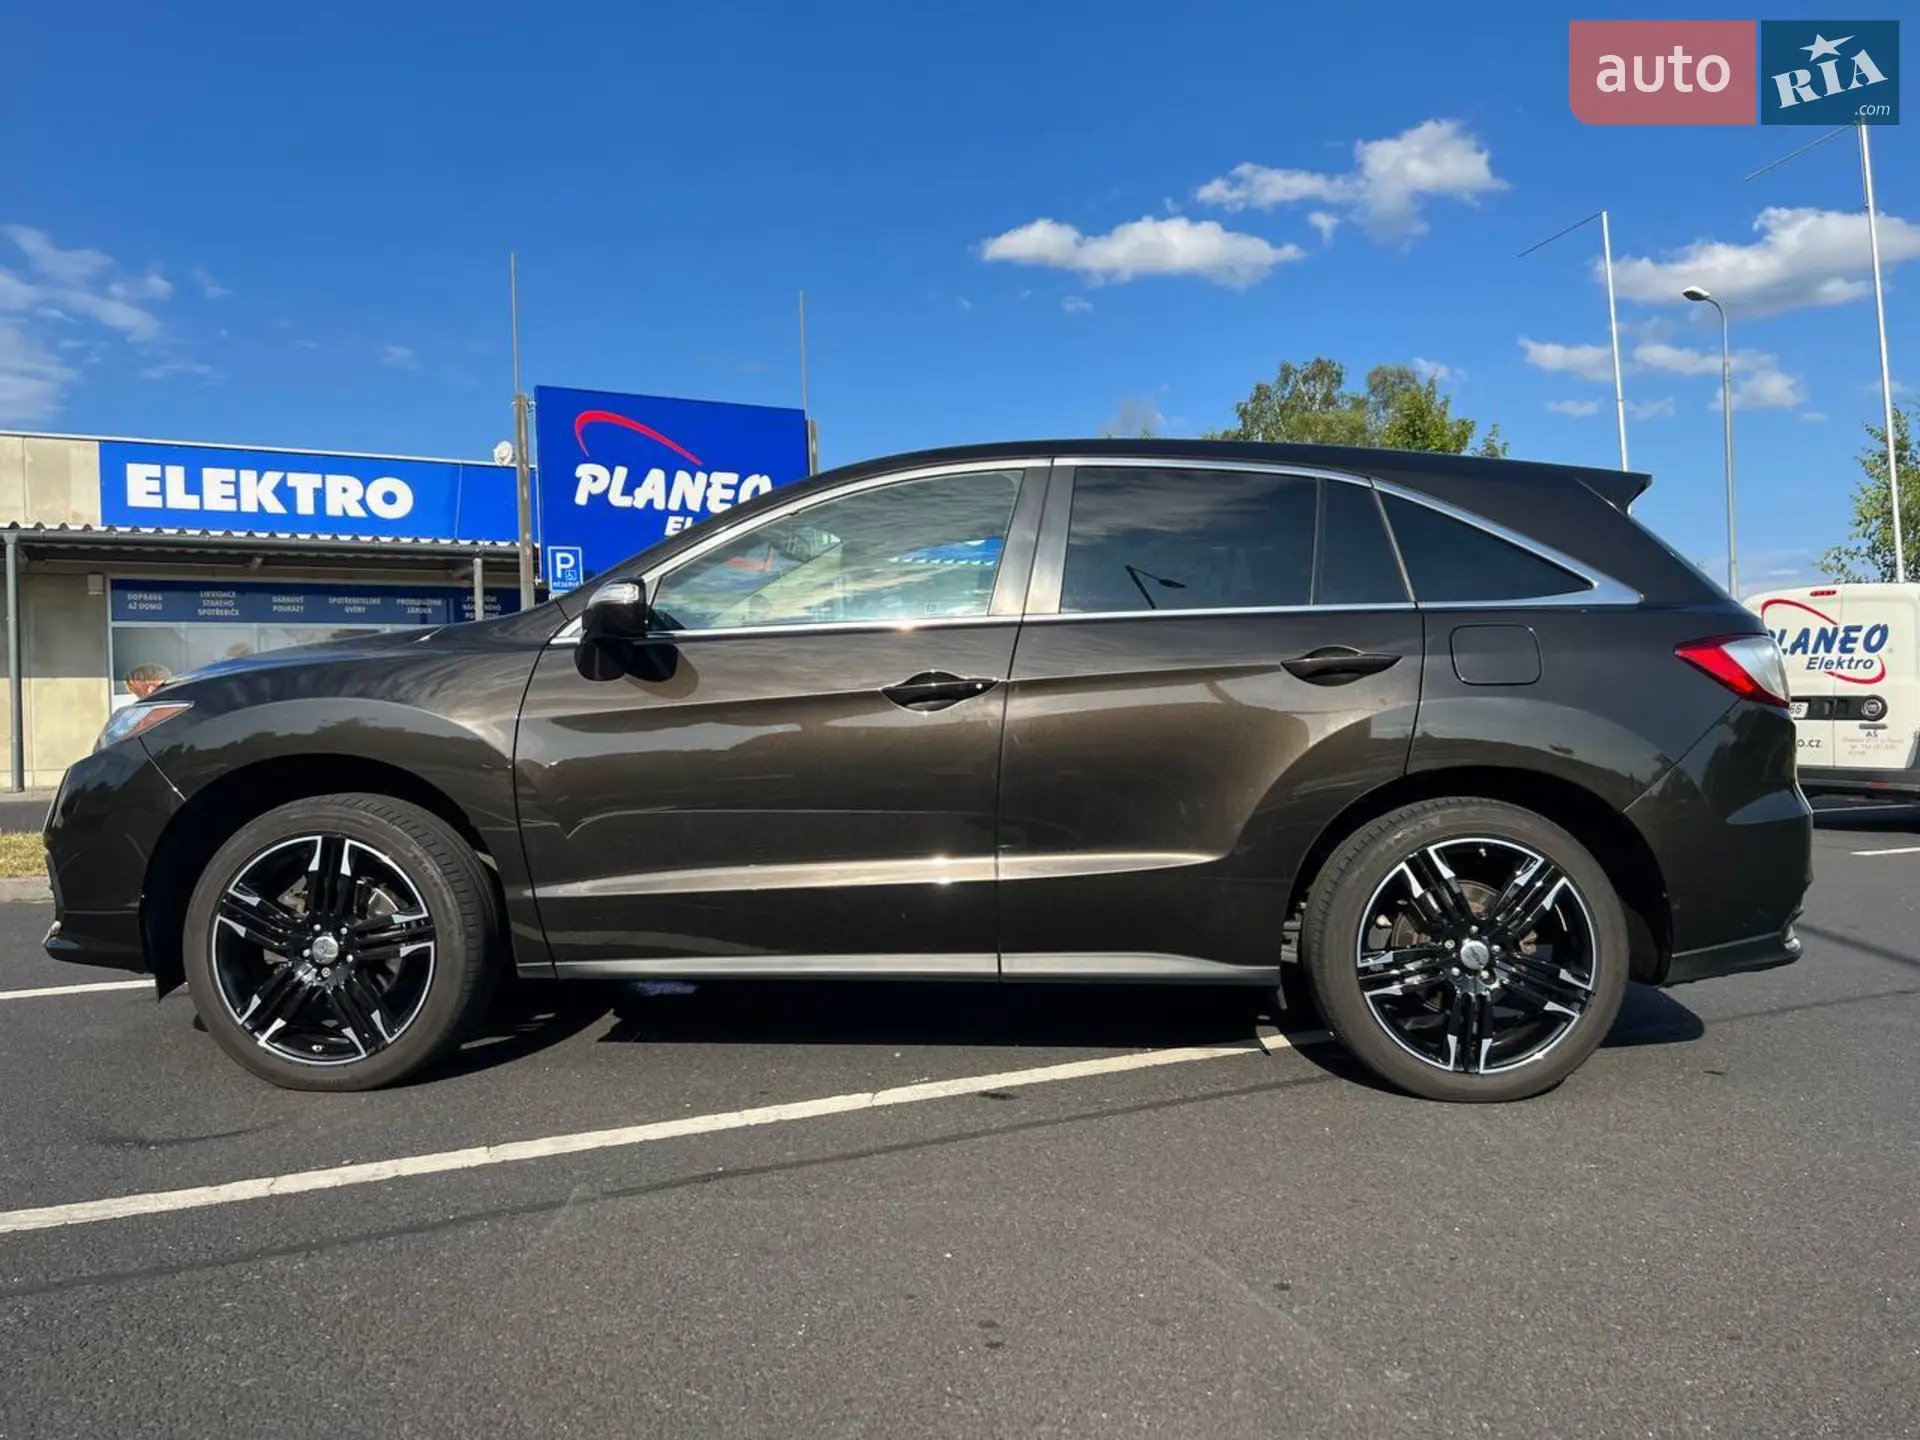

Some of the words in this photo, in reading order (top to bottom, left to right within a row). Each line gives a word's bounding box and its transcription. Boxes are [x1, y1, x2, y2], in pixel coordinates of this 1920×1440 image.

[126, 462, 414, 519] ELEKTRO
[556, 552, 575, 578] P
[1768, 624, 1889, 655] LANEO
[1806, 656, 1874, 670] Elektro
